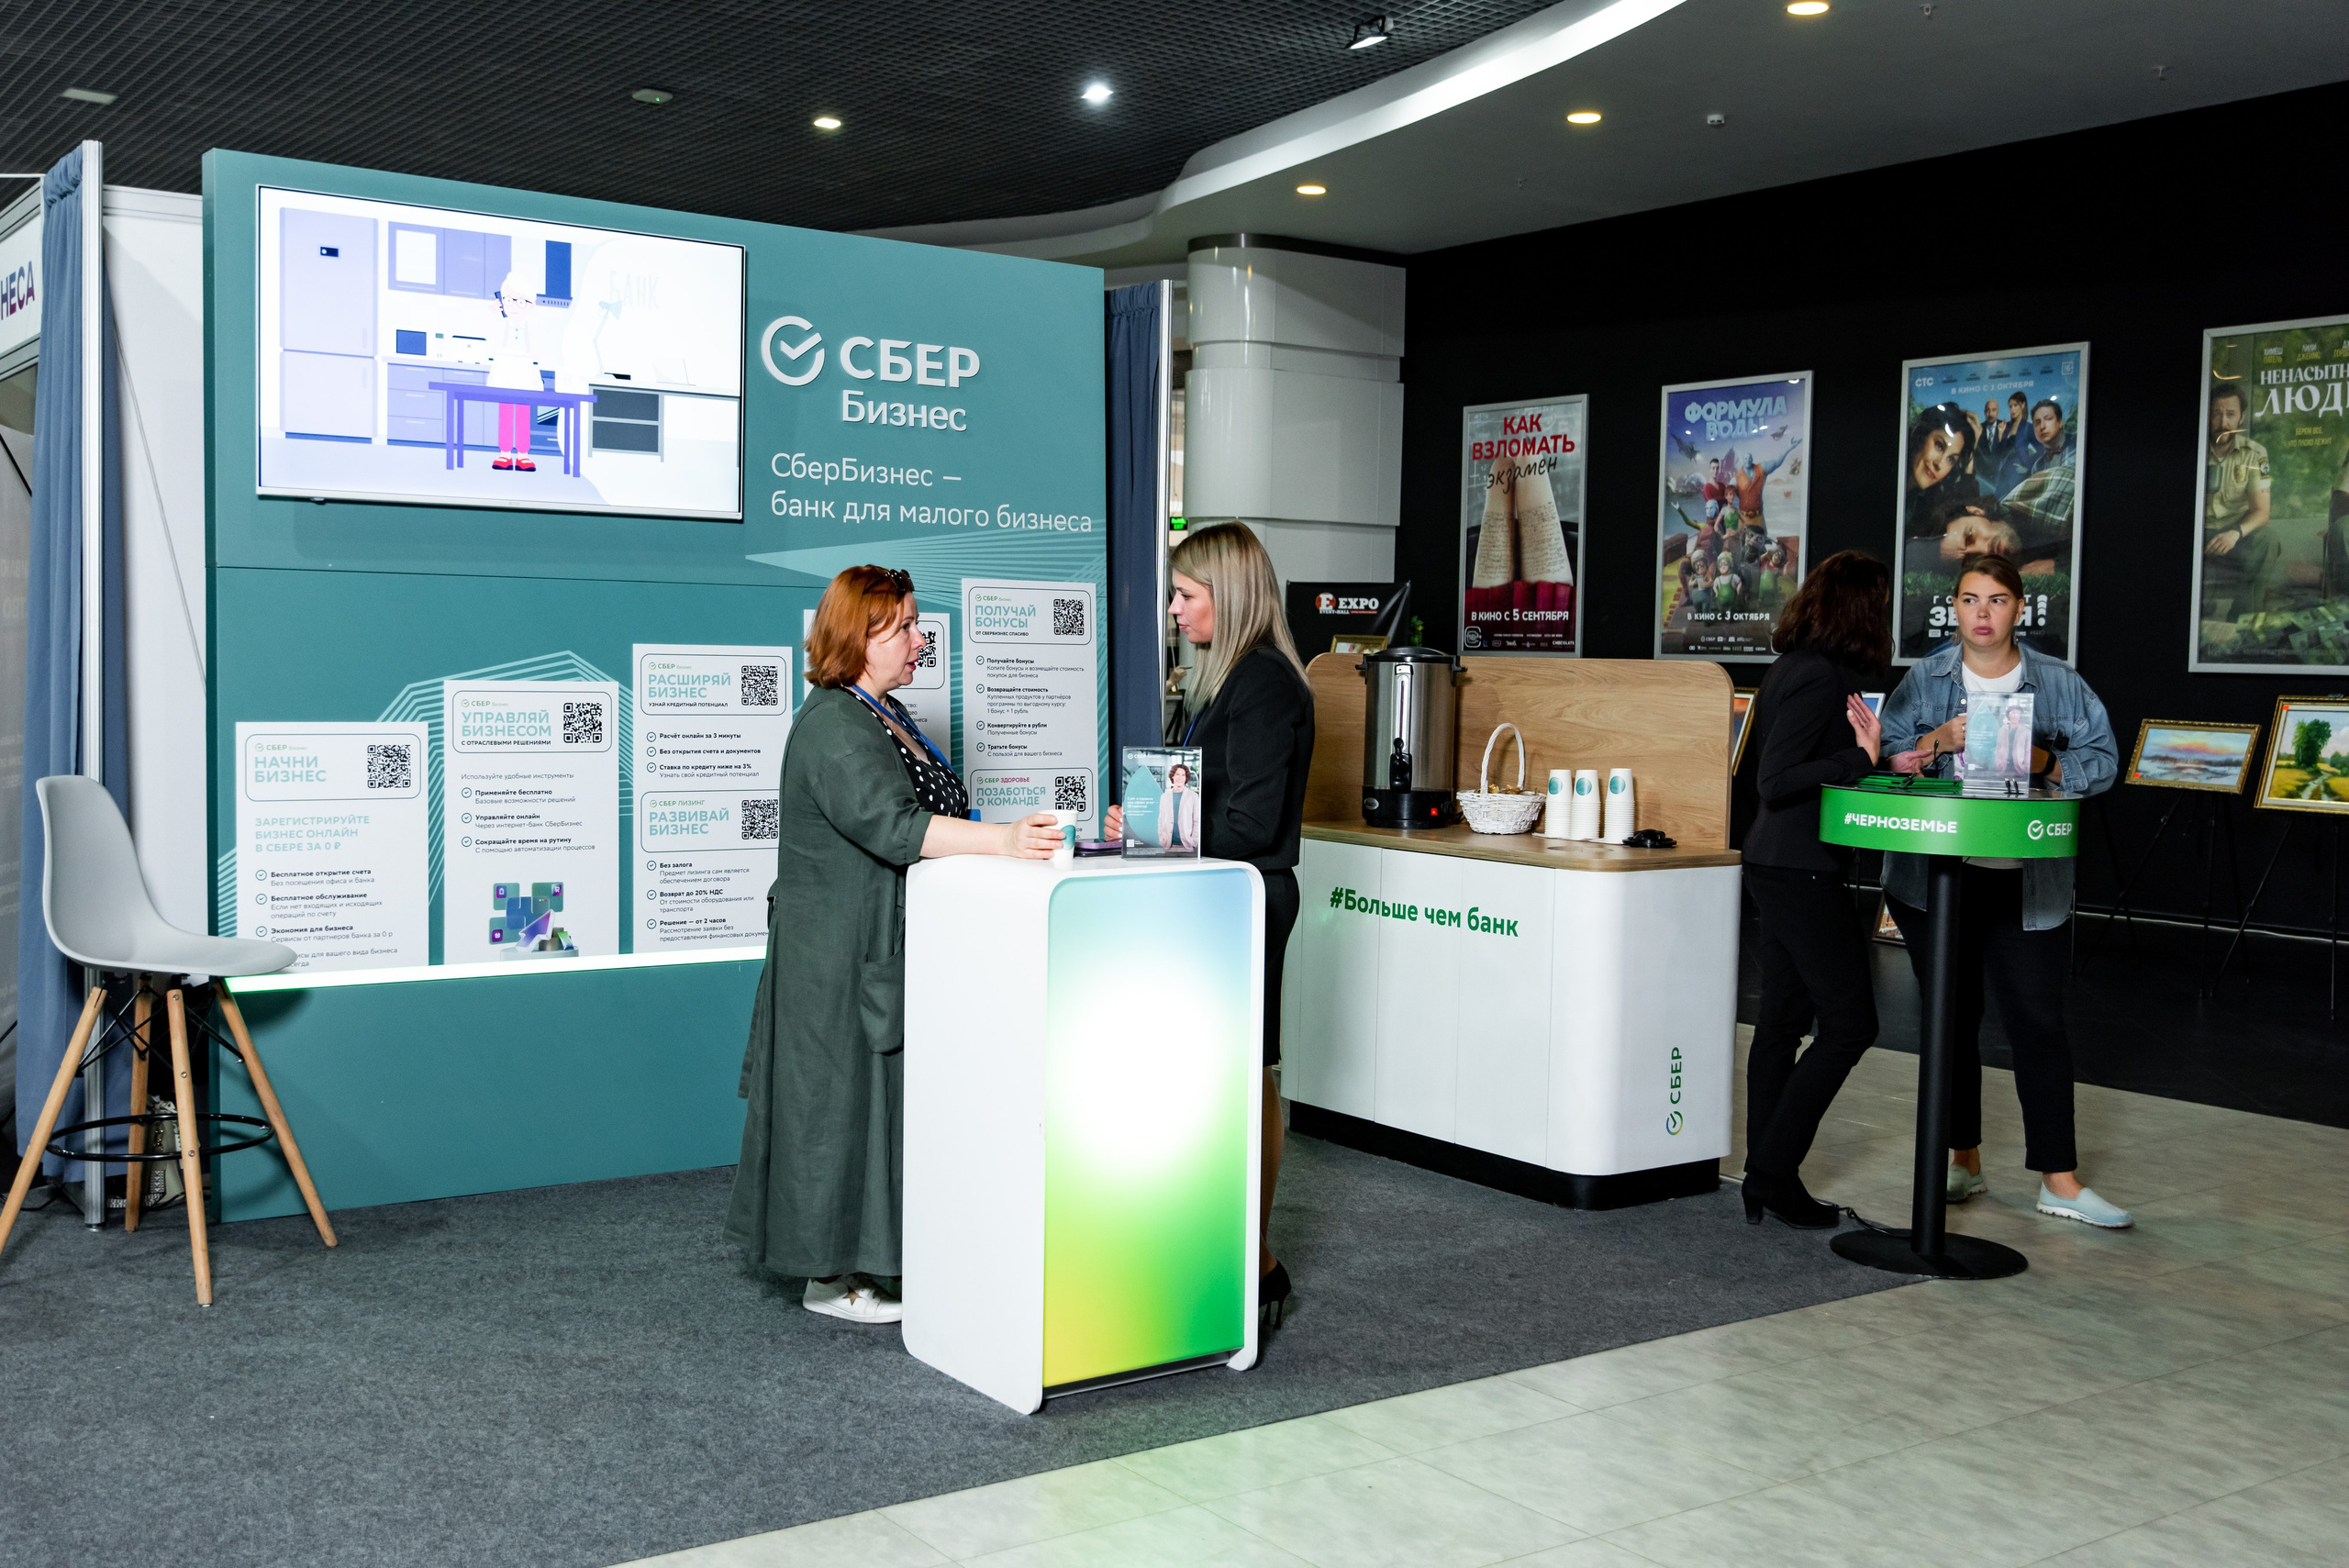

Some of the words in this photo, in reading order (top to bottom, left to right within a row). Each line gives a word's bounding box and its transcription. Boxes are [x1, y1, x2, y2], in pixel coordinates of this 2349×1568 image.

[840, 336, 981, 388] СБЕР
[1915, 377, 1934, 388] СТС
[1997, 381, 2034, 390] ОКТЯБРЯ
[2254, 382, 2349, 418] ЛЮД
[841, 389, 967, 432] Бизнес
[1685, 395, 1787, 424] ФОРМУЛА
[1503, 413, 1542, 436] КАК
[1706, 417, 1765, 441] ВОДЫ
[1472, 434, 1575, 461] ВЗЛОМАТЬ
[771, 452, 933, 487] СберБизнес
[1486, 456, 1558, 495] экзамен
[771, 489, 836, 518] банк
[843, 502, 891, 524] для
[899, 504, 989, 528] малого
[996, 504, 1092, 532] бизнеса
[1338, 597, 1379, 610] EXPO
[975, 605, 1036, 617] ПОЛУЧАЙ
[1471, 611, 1477, 621] В
[1478, 611, 1502, 621] КИНО
[1504, 611, 1510, 621] С
[1512, 608, 1520, 621] 5
[1521, 611, 1569, 621] СЕНТЯБРЯ
[1687, 613, 1693, 621] В
[1694, 612, 1715, 621] КИНО
[1717, 613, 1722, 621] С
[1725, 610, 1731, 621] 3
[1732, 613, 1770, 621] ОКТЯБРЯ
[975, 617, 1028, 628] БОНУСЫ
[649, 673, 731, 685] РАСШИРЯЙ
[649, 686, 707, 698] БИЗНЕС
[462, 709, 550, 724] УПРАВЛЯЙ
[462, 725, 551, 737] БИЗНЕСОМ
[254, 756, 318, 769] НАЧНИ
[254, 770, 327, 783] БИЗНЕС
[504, 773, 532, 781] удобные
[976, 786, 1046, 796] ПОЗАБОТЬСЯ
[976, 798, 985, 806] О
[987, 796, 1040, 806] КОМАНДЕ
[255, 815, 370, 827] ЗАРЕГИСТРИРУЙТЕ
[650, 807, 729, 823] РАЗВИВАЙ
[650, 823, 709, 836] БИЗНЕС
[1843, 812, 1958, 834] #ЧЕРНОЗЕМЬЕ
[2046, 822, 2073, 836] СБЕР
[255, 829, 304, 840] БИЗНЕС
[306, 827, 359, 839] ОНЛАЙН
[255, 844, 263, 852] В
[266, 842, 304, 852] СБЕРЕ
[306, 842, 322, 851] ЗА
[324, 841, 332, 851] 0
[333, 841, 341, 851] ₽
[1330, 886, 1419, 922] #Больше
[1424, 906, 1462, 929] чем
[1467, 906, 1520, 938] банк
[1670, 1046, 1682, 1105] СБЕР
